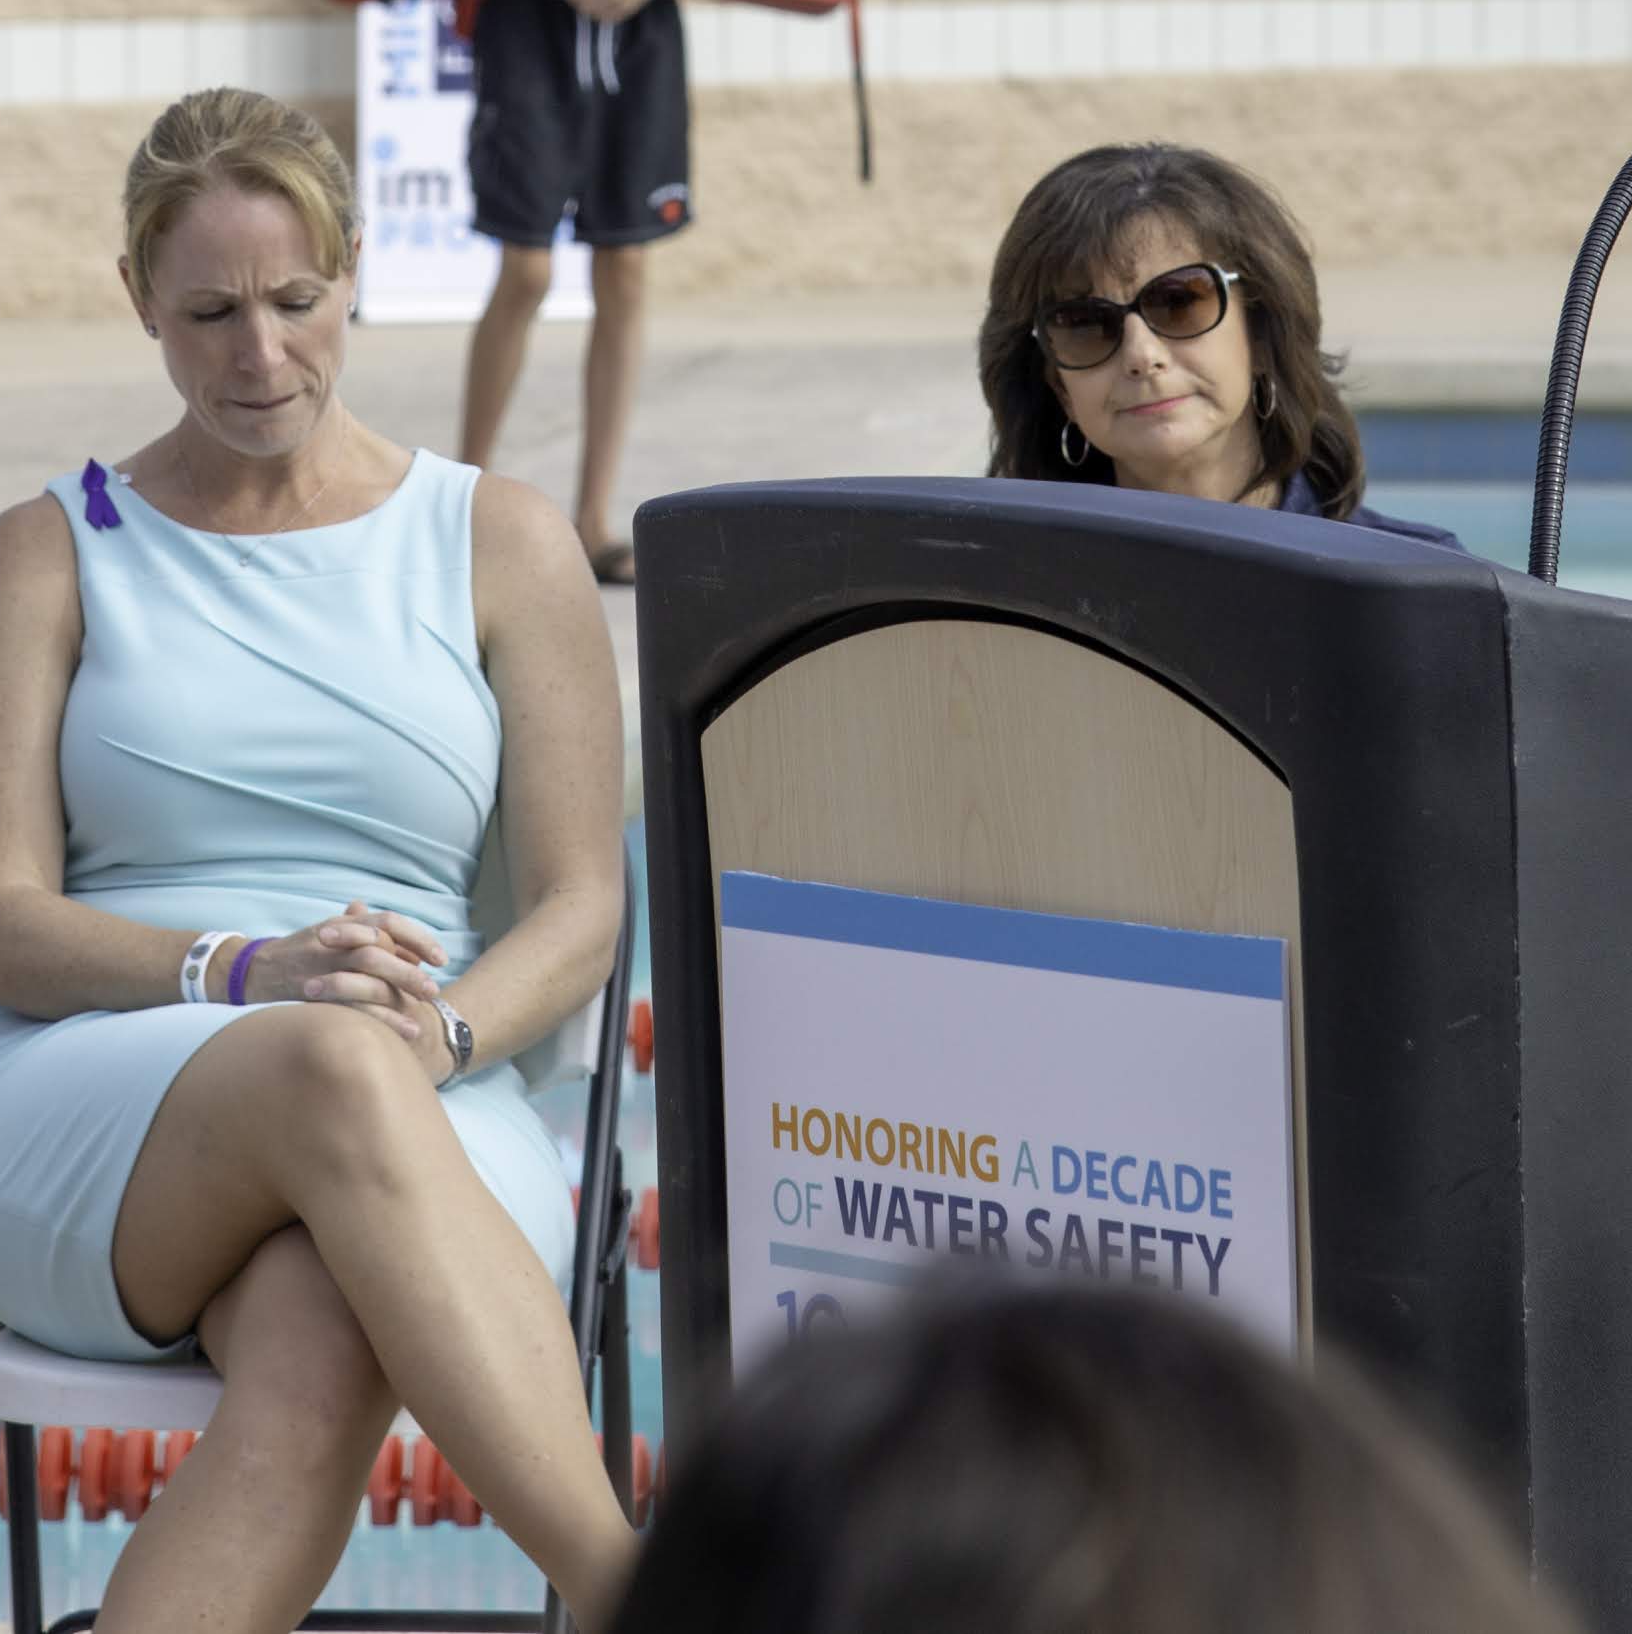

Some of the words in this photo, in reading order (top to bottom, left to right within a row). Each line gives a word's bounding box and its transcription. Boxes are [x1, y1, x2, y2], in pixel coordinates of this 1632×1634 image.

[771, 1102, 999, 1183] HONORING
[1012, 1140, 1040, 1190] A
[1051, 1145, 1234, 1219] DECADE
[772, 1177, 824, 1229] OF
[833, 1176, 1009, 1263] WATER
[1024, 1207, 1232, 1297] SAFETY
